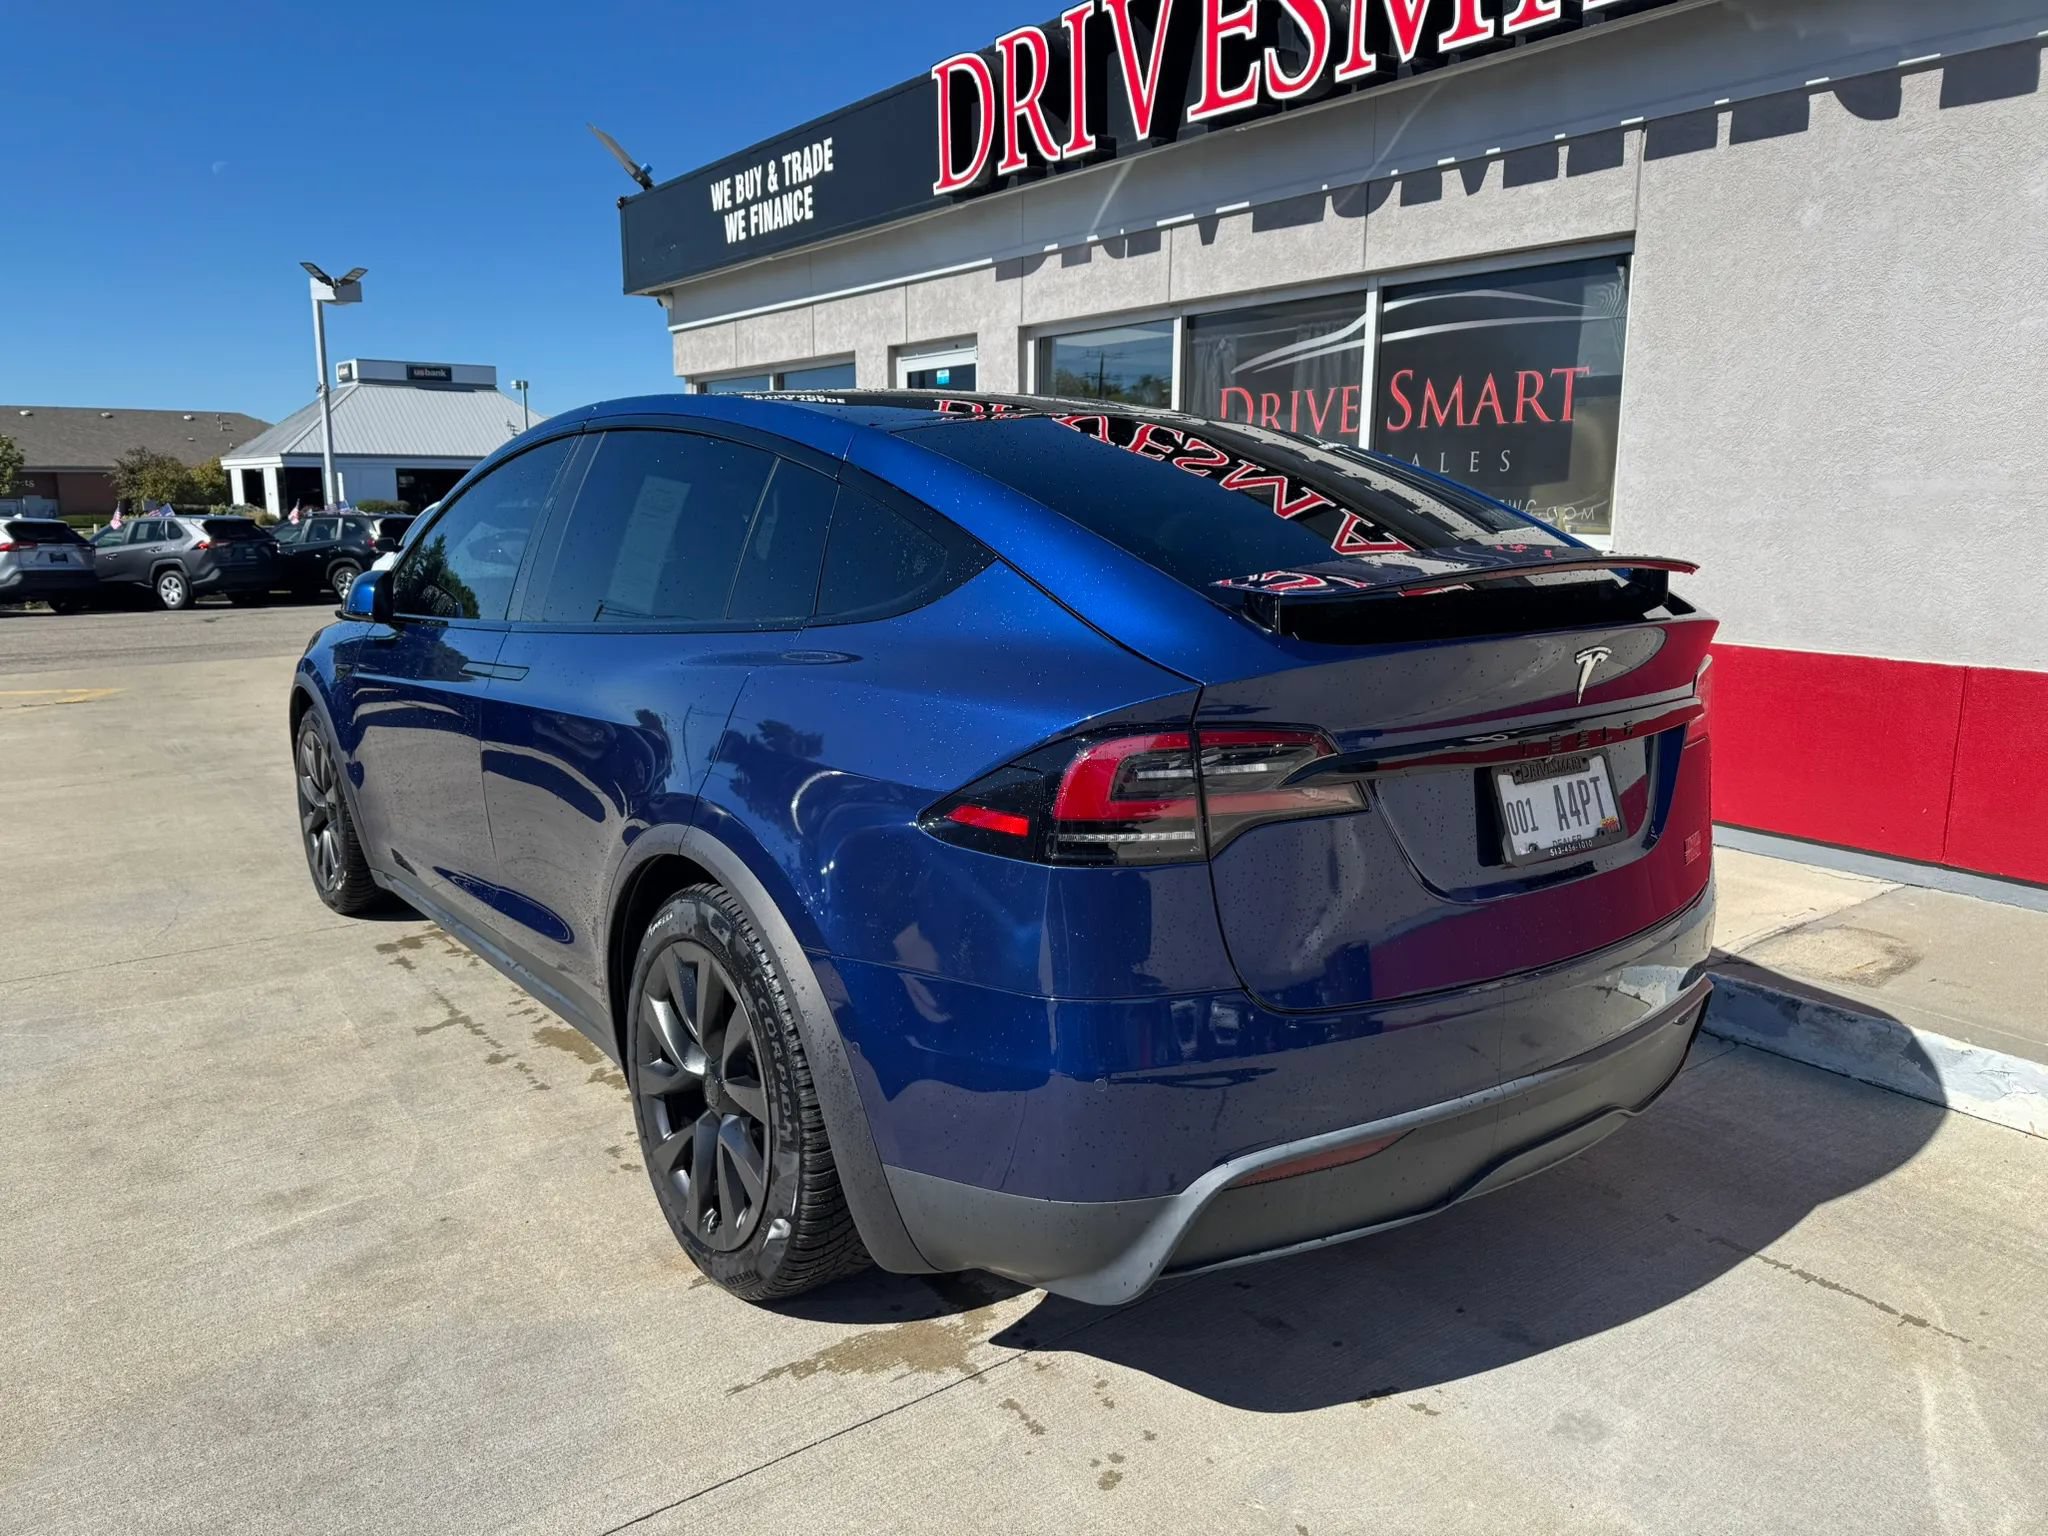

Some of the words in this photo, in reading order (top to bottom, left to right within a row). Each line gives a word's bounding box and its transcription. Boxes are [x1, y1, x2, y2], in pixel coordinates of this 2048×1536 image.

[710, 177, 732, 212] WE
[734, 164, 762, 204] BUY
[767, 159, 779, 193] &
[781, 136, 834, 187] TRADE
[724, 208, 747, 244] WE
[749, 185, 814, 237] FINANCE
[1219, 385, 1361, 435] DRIVE
[1386, 366, 1590, 432] SMART
[1386, 449, 1511, 474] ALES
[1506, 797, 1539, 836] 001
[1552, 776, 1606, 831] A4PT
